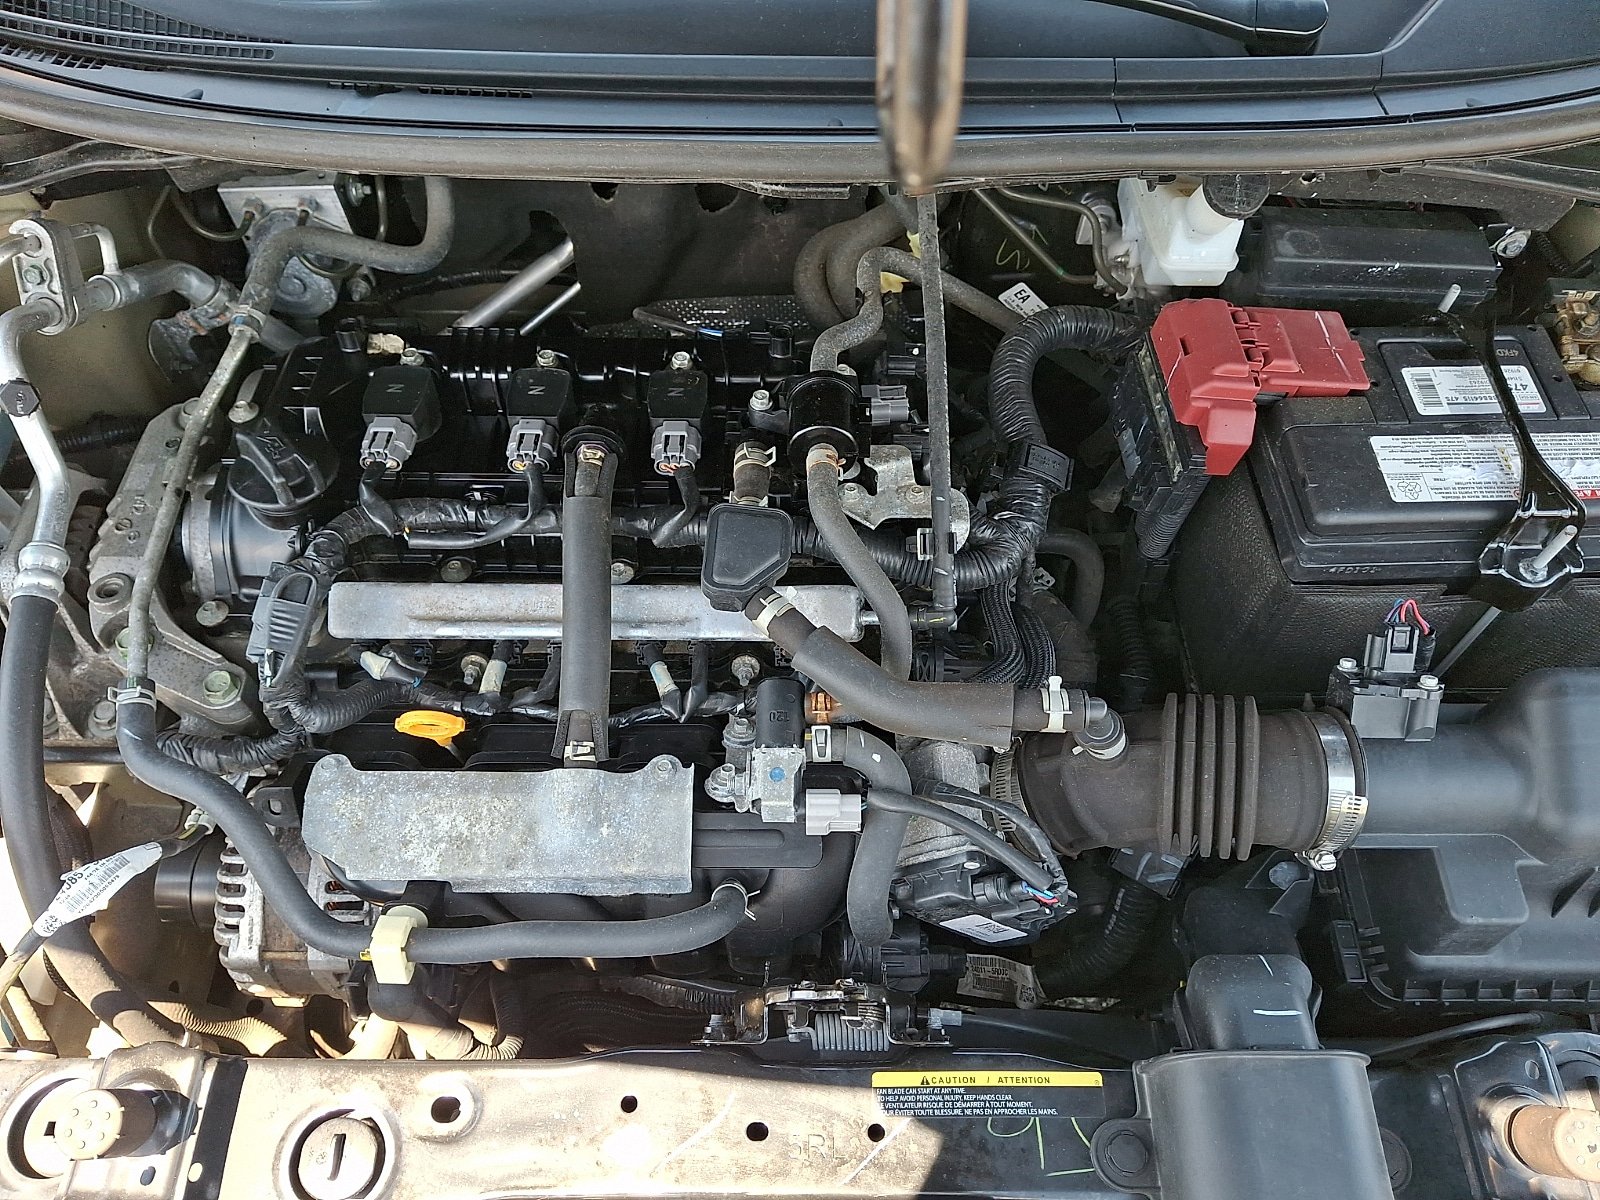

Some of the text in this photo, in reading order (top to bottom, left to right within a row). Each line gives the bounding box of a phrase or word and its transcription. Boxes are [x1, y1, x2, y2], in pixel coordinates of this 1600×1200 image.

[1014, 289, 1031, 304] EA
[931, 1076, 976, 1084] CAUTION
[997, 1076, 1050, 1084] ATTENTION
[953, 1100, 985, 1108] DÉMARRER
